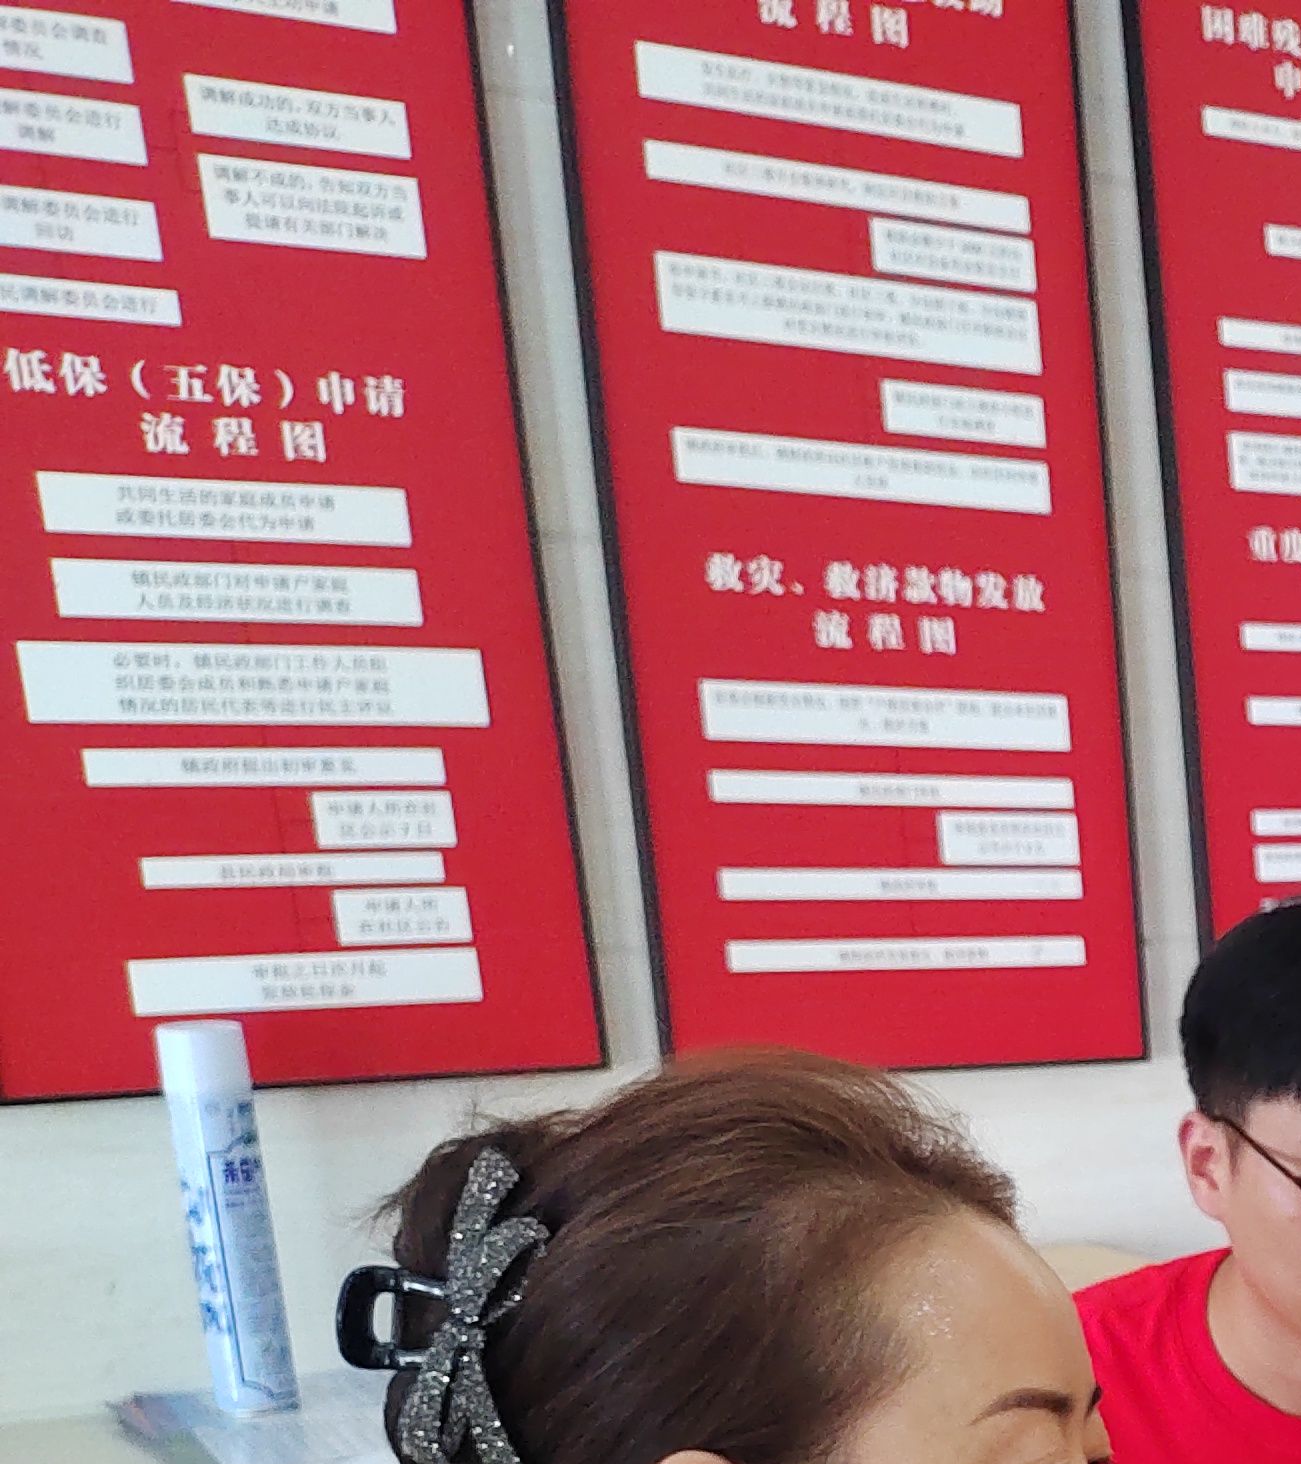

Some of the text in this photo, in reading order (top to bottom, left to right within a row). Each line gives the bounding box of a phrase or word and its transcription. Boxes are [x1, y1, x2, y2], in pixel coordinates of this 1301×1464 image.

[3, 347, 405, 418] 低保（五保）申请
[140, 412, 327, 463] 流程图
[813, 609, 957, 655] 流程图
